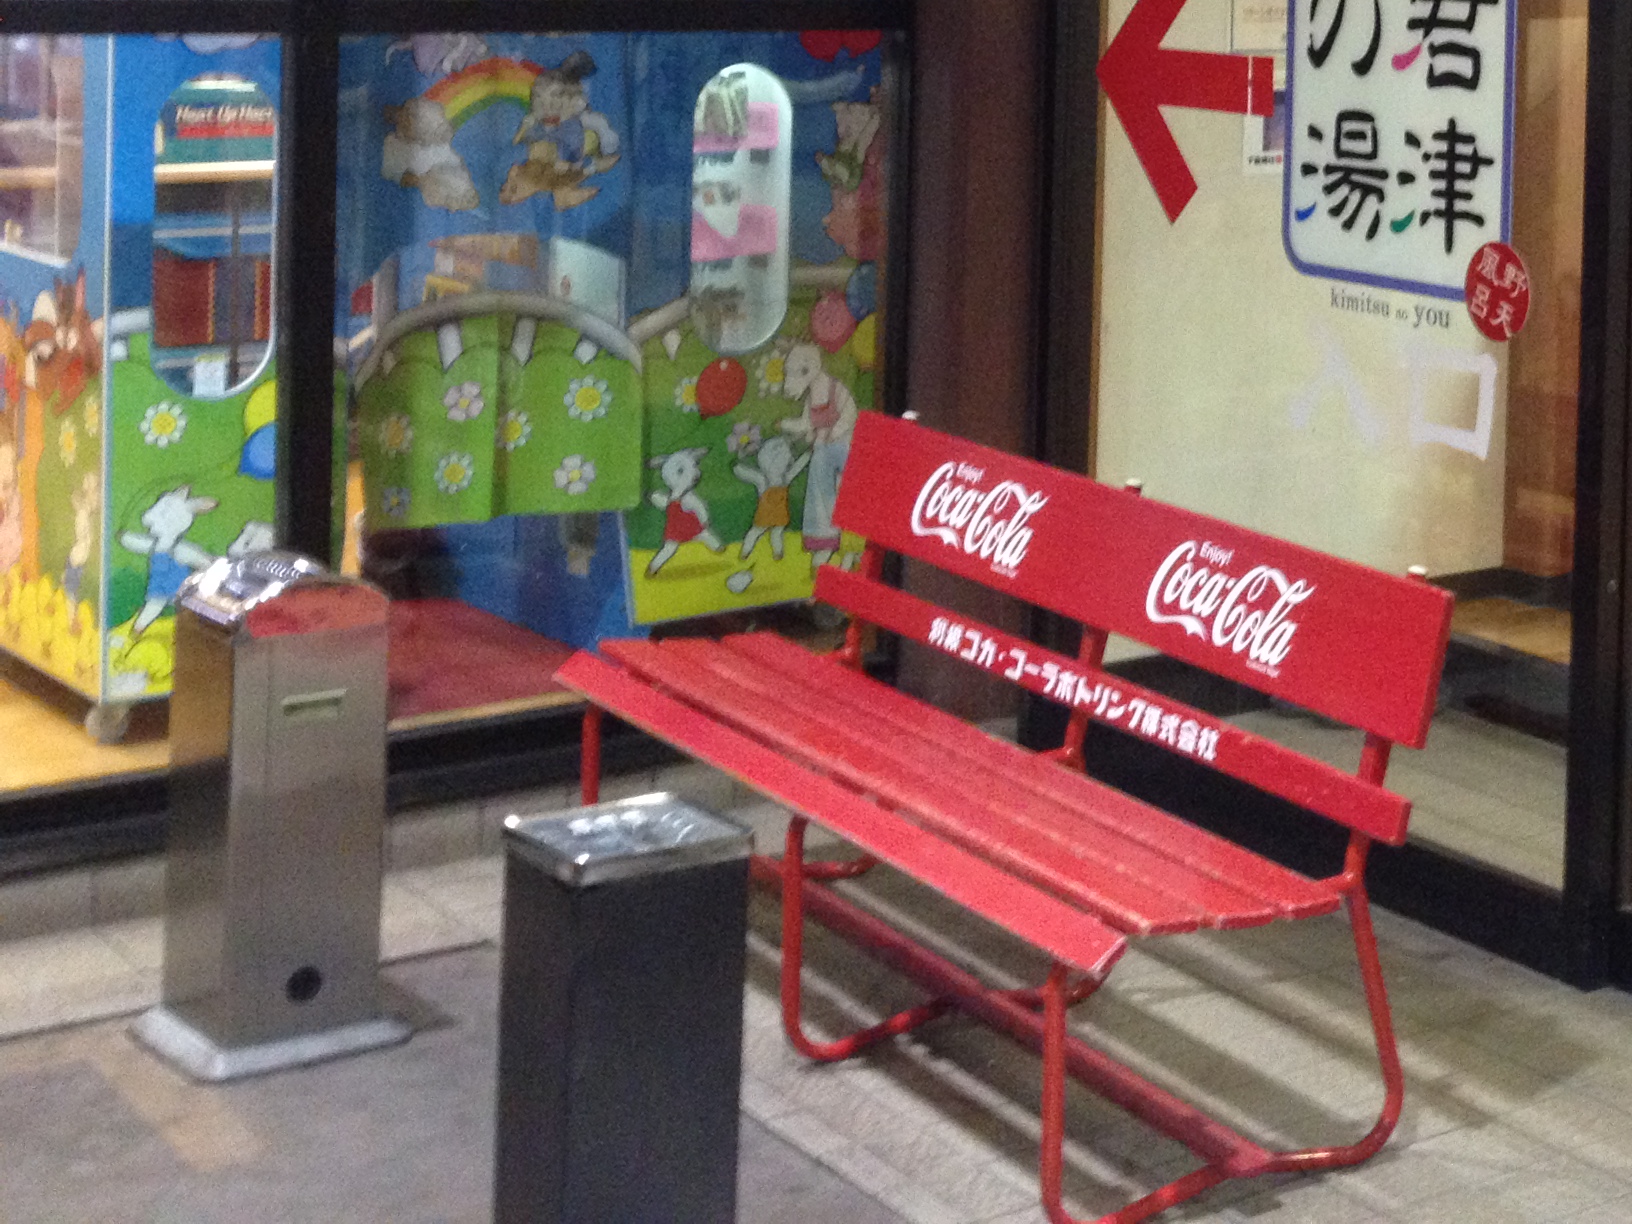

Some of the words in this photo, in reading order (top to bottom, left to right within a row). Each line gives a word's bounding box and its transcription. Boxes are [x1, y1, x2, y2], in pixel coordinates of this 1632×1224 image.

[1329, 287, 1391, 317] kimitsu
[1412, 303, 1451, 329] you
[911, 460, 1051, 569] Coca-Cola
[1145, 539, 1317, 666] Coca-Cola
